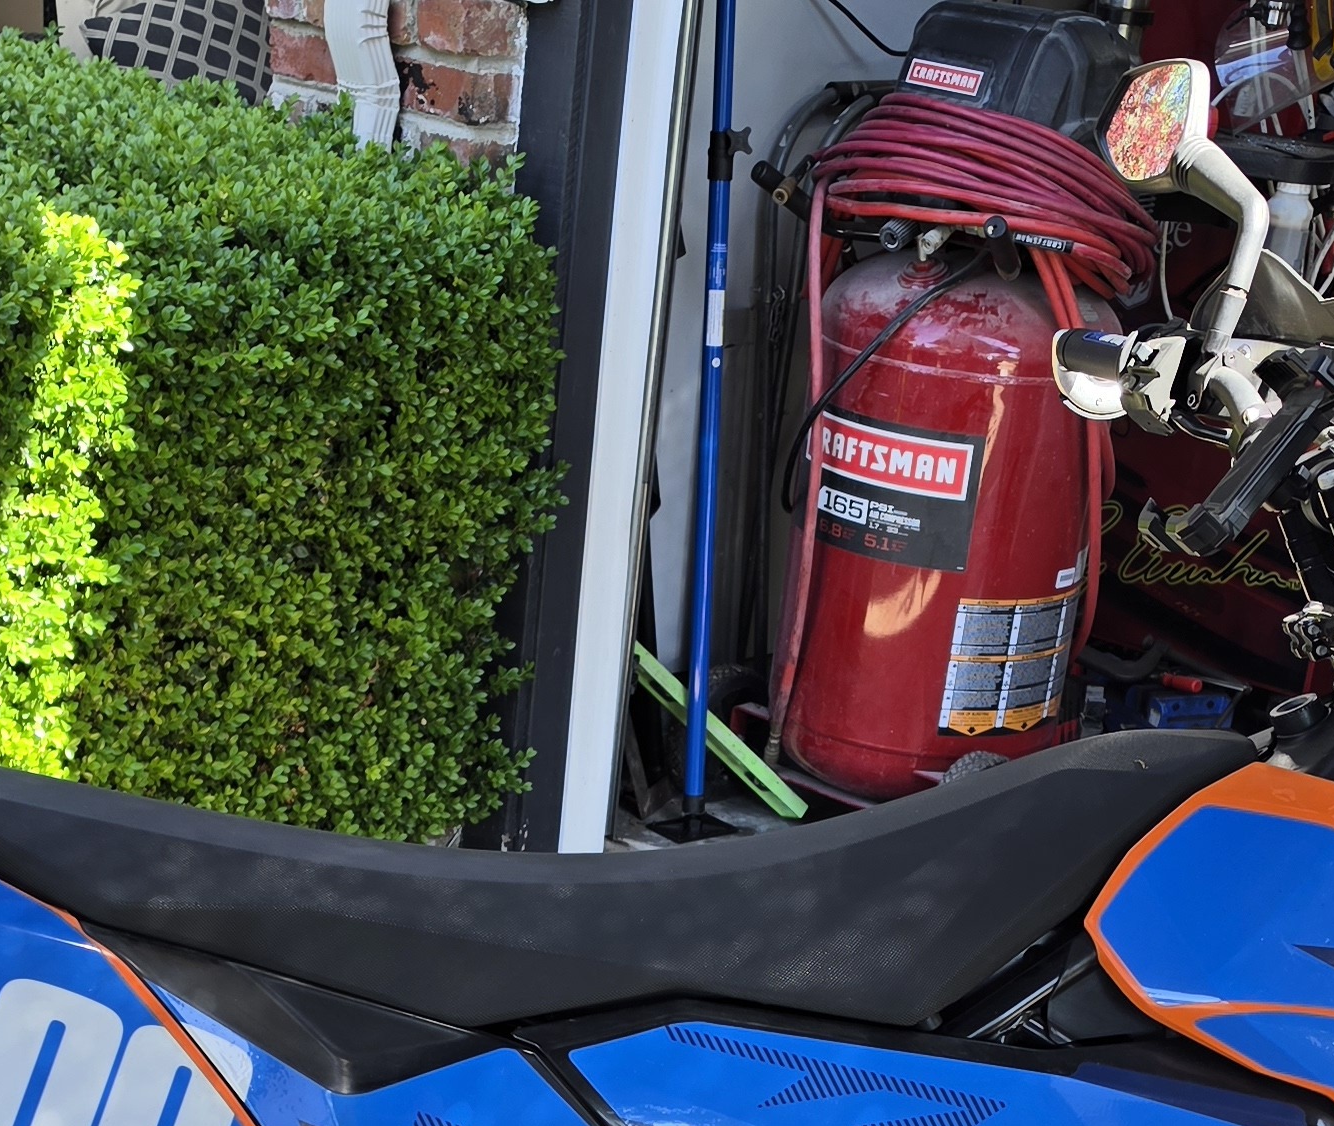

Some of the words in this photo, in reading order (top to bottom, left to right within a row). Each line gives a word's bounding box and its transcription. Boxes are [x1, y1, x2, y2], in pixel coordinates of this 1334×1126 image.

[912, 65, 977, 90] CRAFTSMAN
[821, 426, 958, 485] RAFTSMAN
[823, 490, 864, 519] 165
[870, 501, 895, 514] PSI
[864, 533, 889, 551] 5.1
